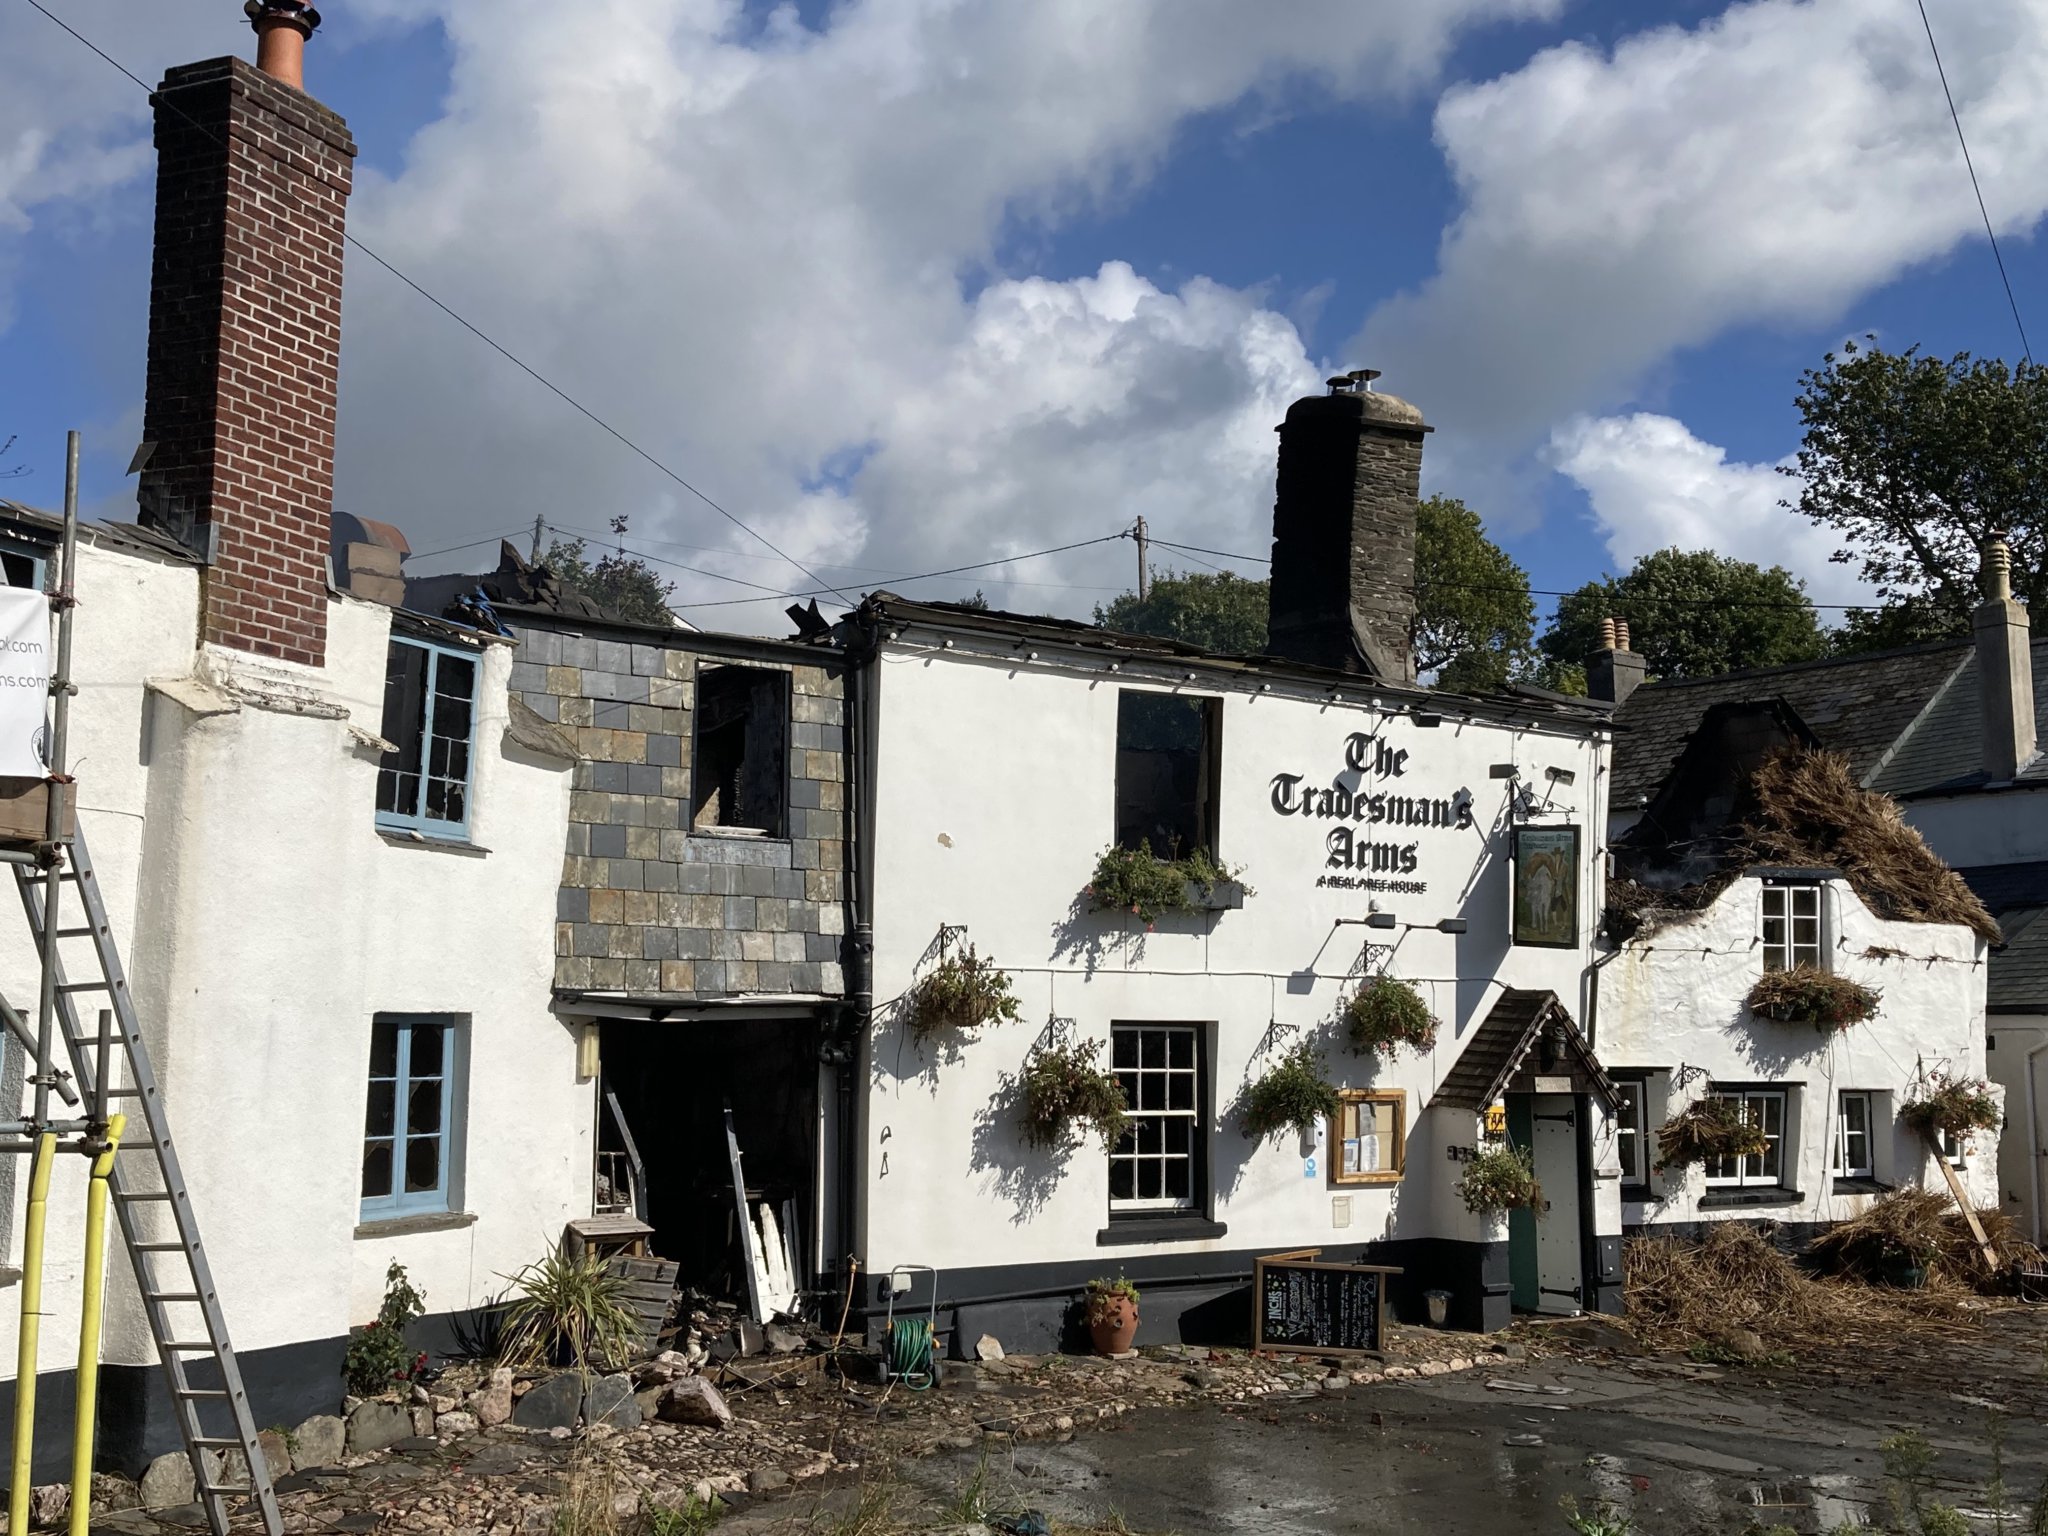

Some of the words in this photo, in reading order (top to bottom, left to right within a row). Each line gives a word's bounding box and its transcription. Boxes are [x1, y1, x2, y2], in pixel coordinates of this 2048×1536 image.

[1344, 731, 1409, 783] The
[1269, 773, 1474, 831] Tradesman's
[1325, 826, 1419, 874] Arms
[1316, 875, 1326, 888] A
[1328, 876, 1358, 890] REAL
[1389, 880, 1427, 894] HOUSE
